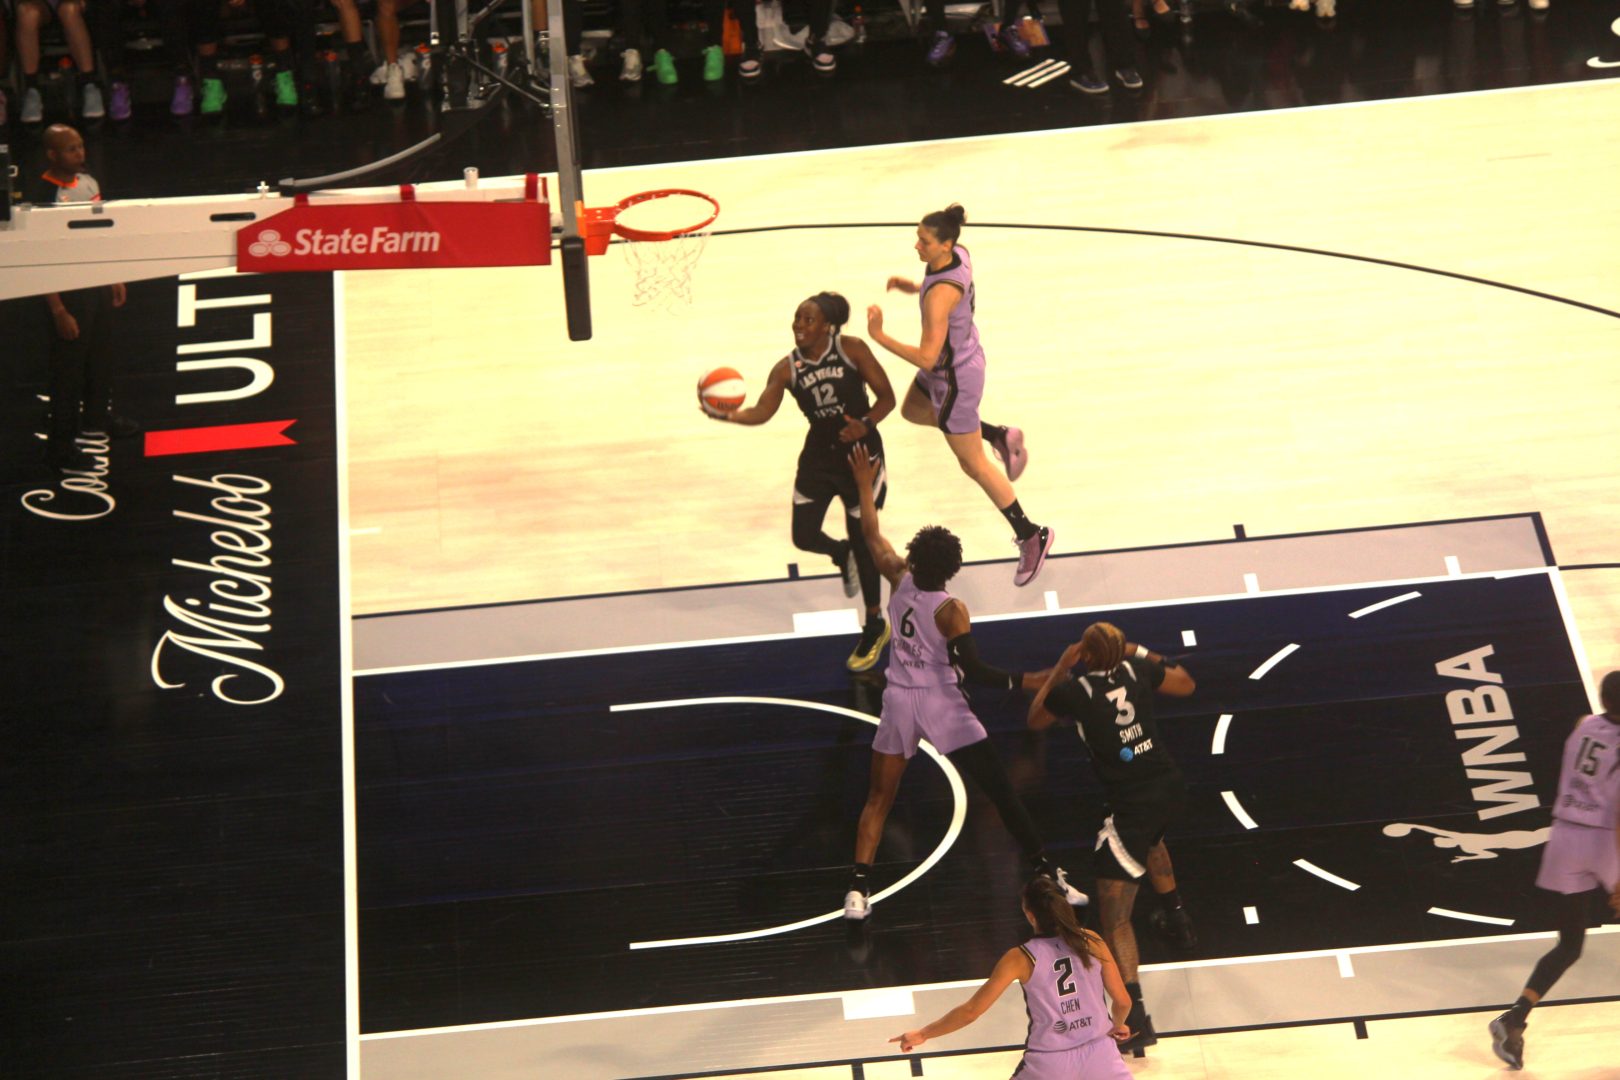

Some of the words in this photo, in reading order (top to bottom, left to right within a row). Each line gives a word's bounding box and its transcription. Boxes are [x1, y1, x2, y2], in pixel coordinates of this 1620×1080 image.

[815, 366, 845, 381] VEGAS
[811, 383, 838, 407] 12
[151, 473, 285, 706] Michelob
[900, 607, 915, 638] 6
[1105, 686, 1136, 726] 3
[1119, 722, 1143, 744] SMITH
[1435, 644, 1541, 821] WNBA
[1134, 738, 1154, 755] AT&T
[1574, 736, 1607, 776] 15
[1053, 955, 1078, 997] 2
[1060, 998, 1081, 1015] CHEN
[1069, 1016, 1092, 1031] AT&T
